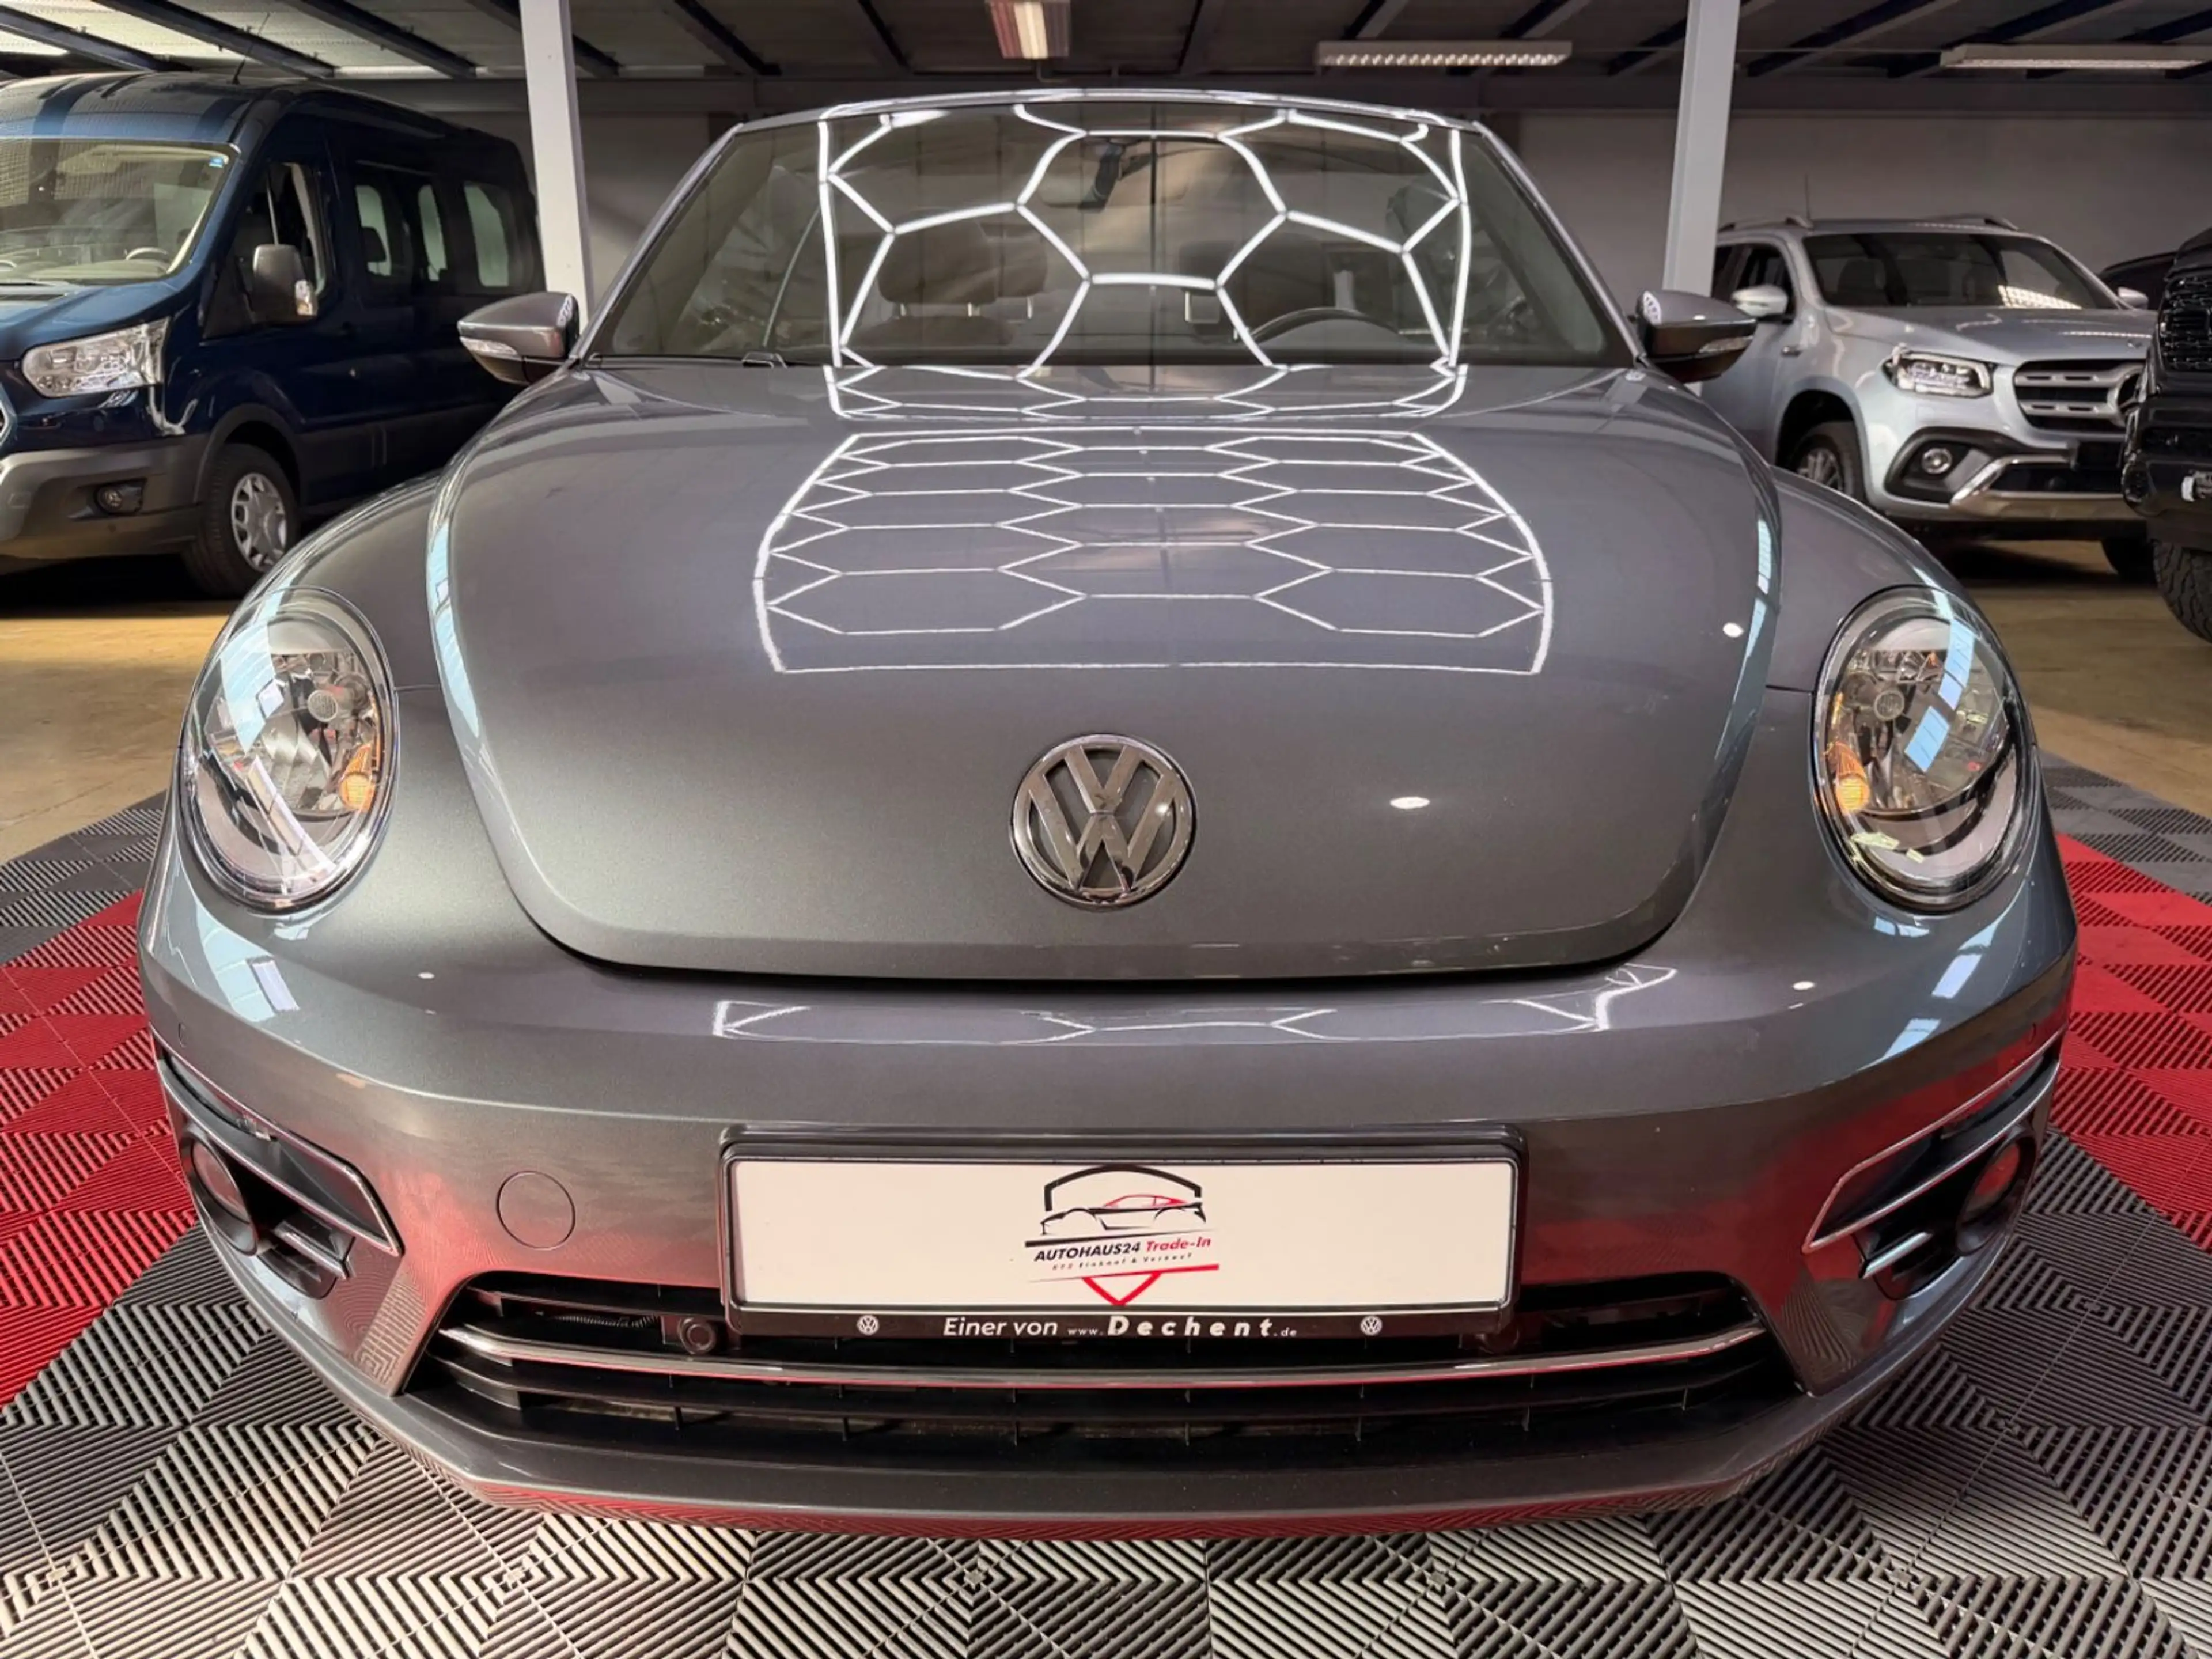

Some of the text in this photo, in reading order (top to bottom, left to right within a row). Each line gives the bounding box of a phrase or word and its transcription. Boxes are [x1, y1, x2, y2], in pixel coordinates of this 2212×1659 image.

[1034, 1237, 1211, 1262] AUTOHAUS24 Trade-In
[943, 1316, 1007, 1336] Einer
[1013, 1321, 1058, 1336] von
